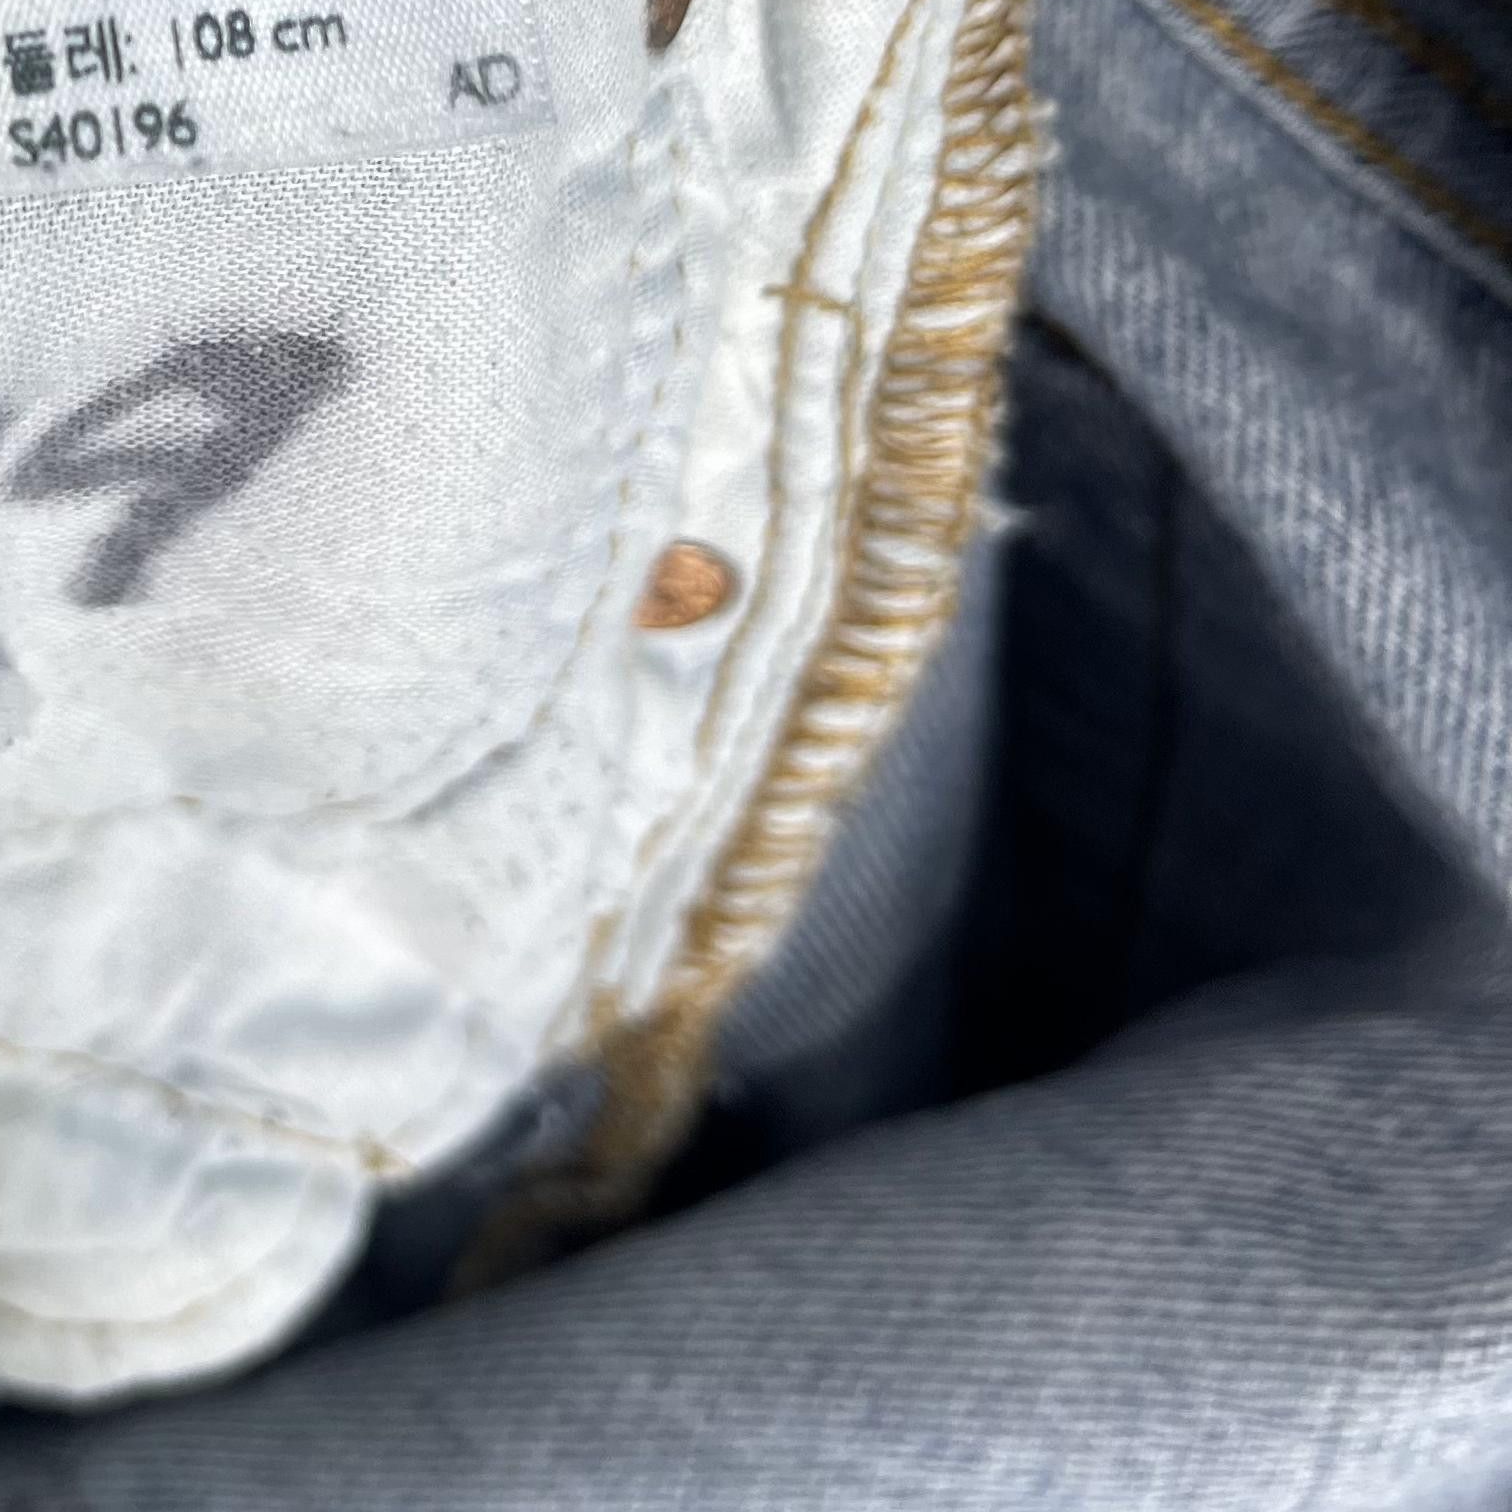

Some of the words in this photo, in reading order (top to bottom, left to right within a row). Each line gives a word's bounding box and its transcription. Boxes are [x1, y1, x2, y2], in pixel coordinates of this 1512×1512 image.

[170, 7, 257, 72] 108
[272, 9, 349, 56] cm
[7, 99, 199, 169] S40196
